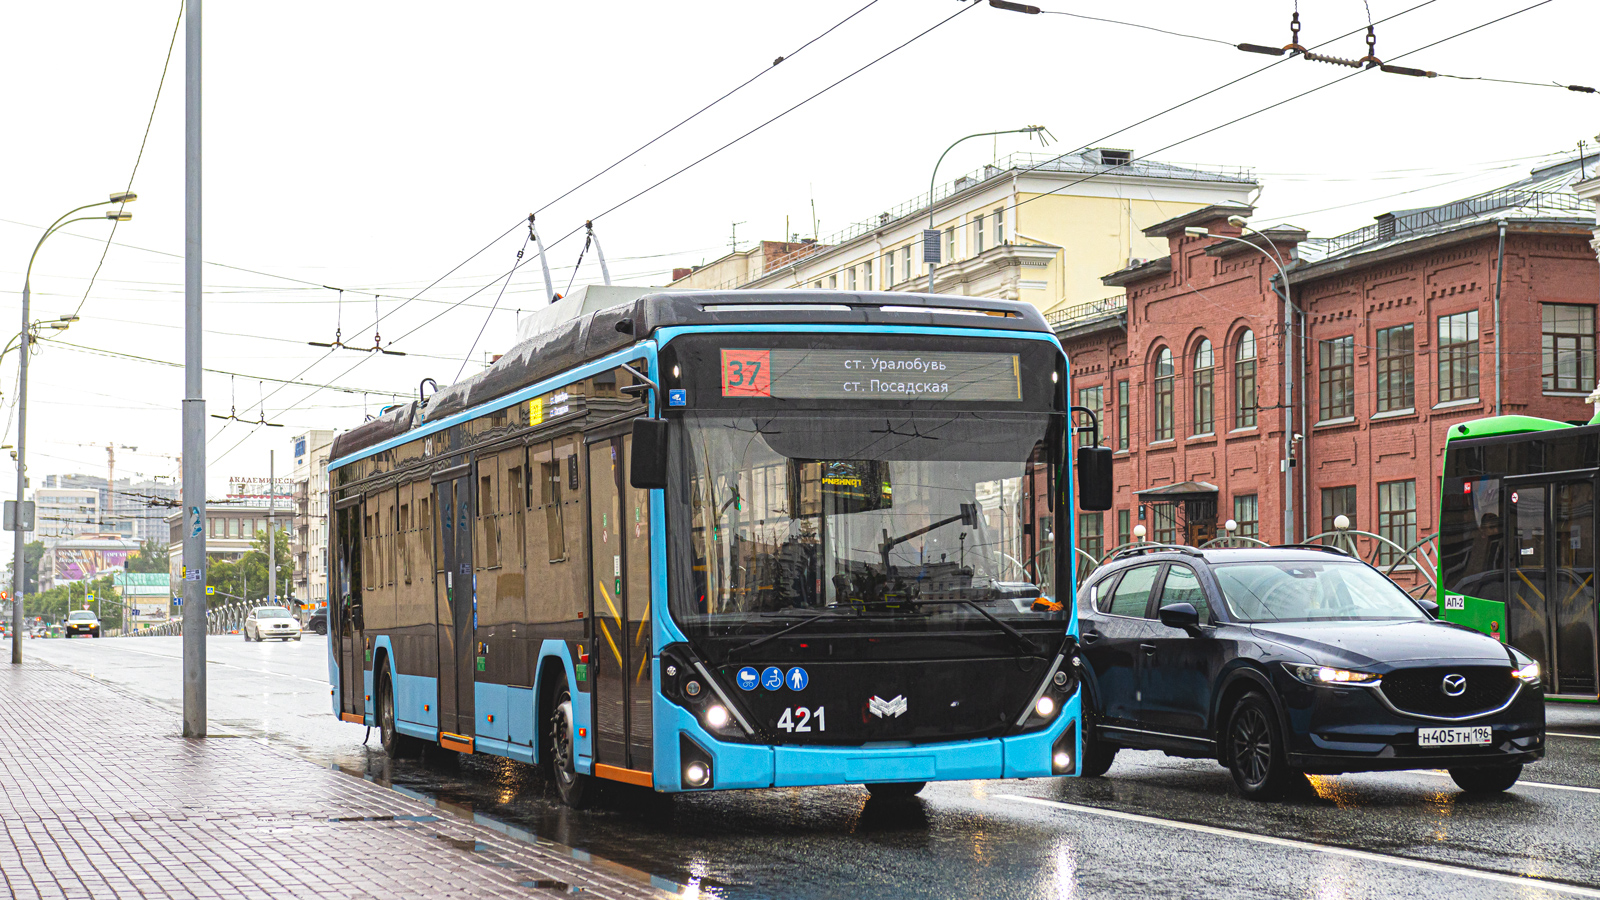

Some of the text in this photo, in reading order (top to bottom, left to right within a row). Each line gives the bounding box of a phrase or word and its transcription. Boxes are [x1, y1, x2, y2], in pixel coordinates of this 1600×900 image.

[729, 360, 761, 386] 37
[844, 357, 947, 373] ст. Уралобувь
[843, 379, 948, 395] ст. Посадская
[1446, 597, 1464, 608] АП-2
[777, 706, 825, 733] 421
[1423, 728, 1489, 744] Н405ТН 196
